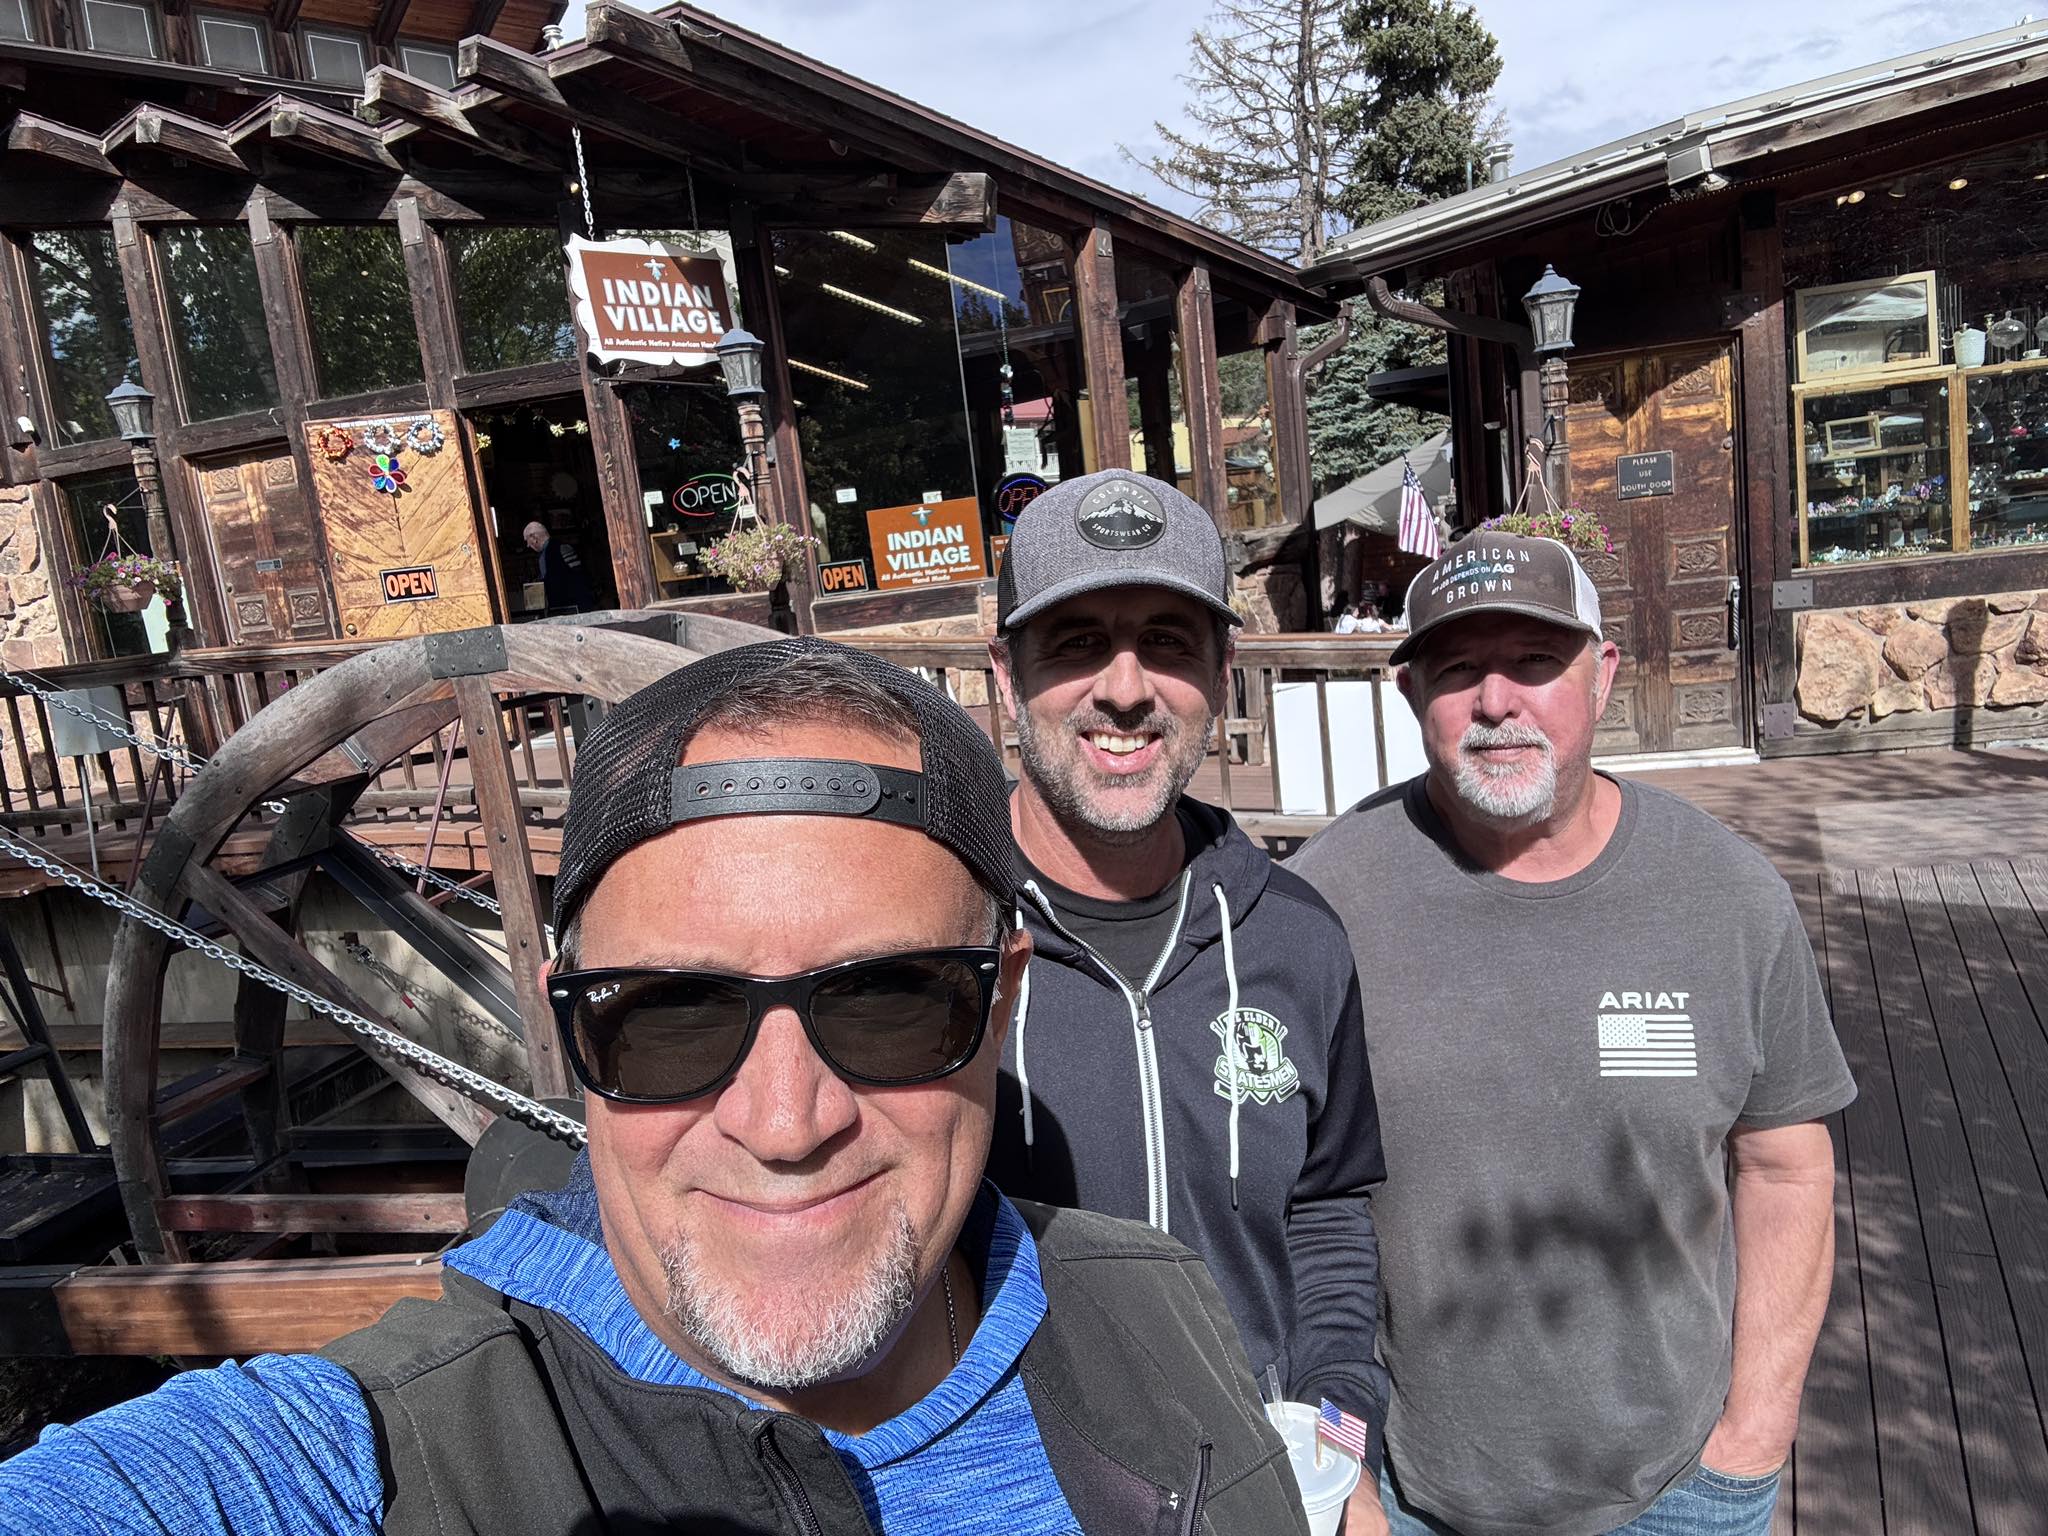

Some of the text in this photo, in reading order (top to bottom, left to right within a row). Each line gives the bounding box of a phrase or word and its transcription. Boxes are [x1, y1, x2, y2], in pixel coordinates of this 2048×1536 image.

[602, 278, 714, 309] INDIAN
[603, 304, 724, 335] VILLAGE
[615, 338, 647, 346] Authentic
[648, 339, 670, 347] Native
[671, 340, 700, 348] American
[1632, 456, 1658, 466] PLEASE
[1638, 469, 1653, 478] USE
[680, 481, 737, 508] OPEN
[1091, 485, 1150, 505] COLUMBIA
[1621, 480, 1672, 492] SOUTH DOOR
[887, 525, 964, 551] INDIAN
[1091, 522, 1142, 538] SPORTSWEAR
[886, 545, 971, 572] VILLAGE
[1432, 547, 1530, 583] AMERICAN
[386, 571, 434, 598] OPEN
[822, 564, 865, 591] OPEN
[1450, 567, 1480, 584] DEPENDS
[1480, 566, 1491, 574] ON
[1492, 563, 1515, 574] AG
[1446, 579, 1512, 604] GROWN
[1598, 991, 1690, 1010] ARIAT
[1243, 1011, 1275, 1030] ELDER
[1218, 1060, 1295, 1089] SATESMEN
